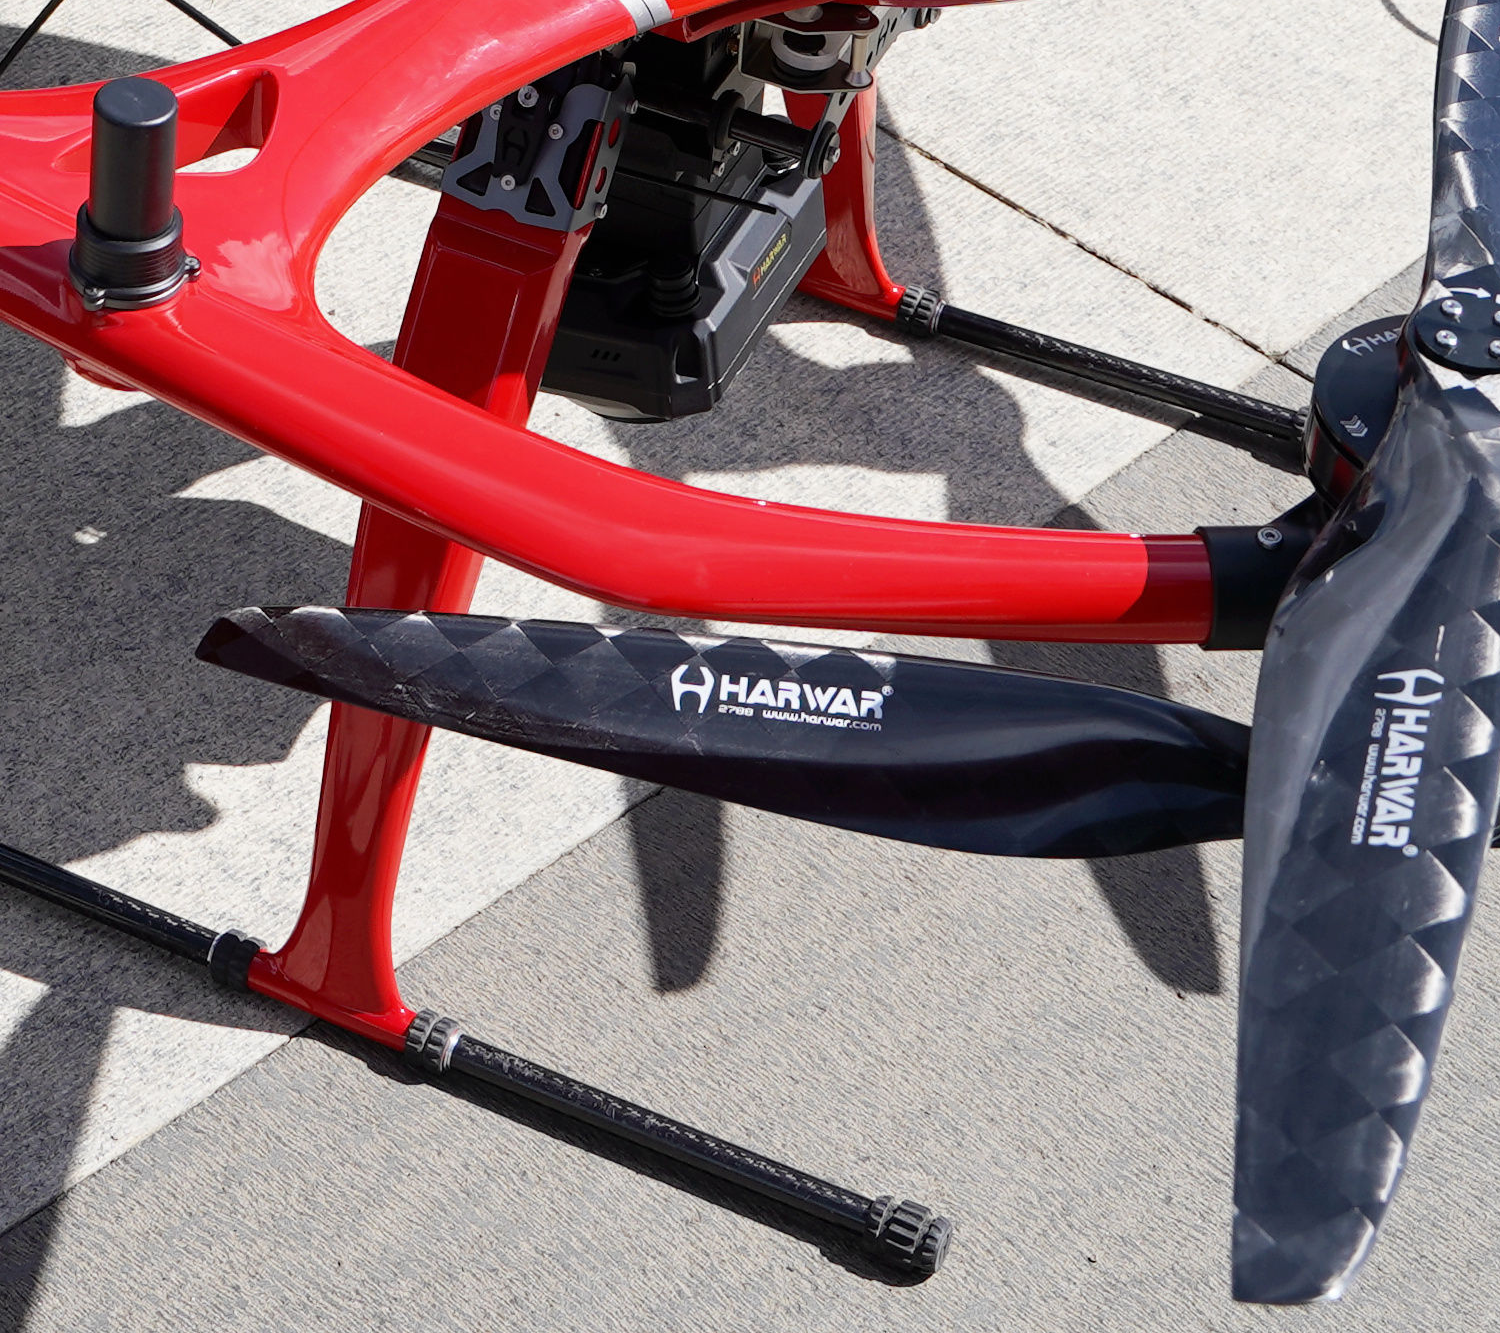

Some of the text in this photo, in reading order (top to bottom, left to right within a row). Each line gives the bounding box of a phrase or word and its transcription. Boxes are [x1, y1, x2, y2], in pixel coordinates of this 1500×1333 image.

[760, 233, 788, 275] HARWAR
[719, 674, 884, 719] HARWAR
[762, 709, 882, 732] www.harwar.com
[1350, 743, 1380, 845] www.harwar.com
[1367, 708, 1431, 848] HARWAR
